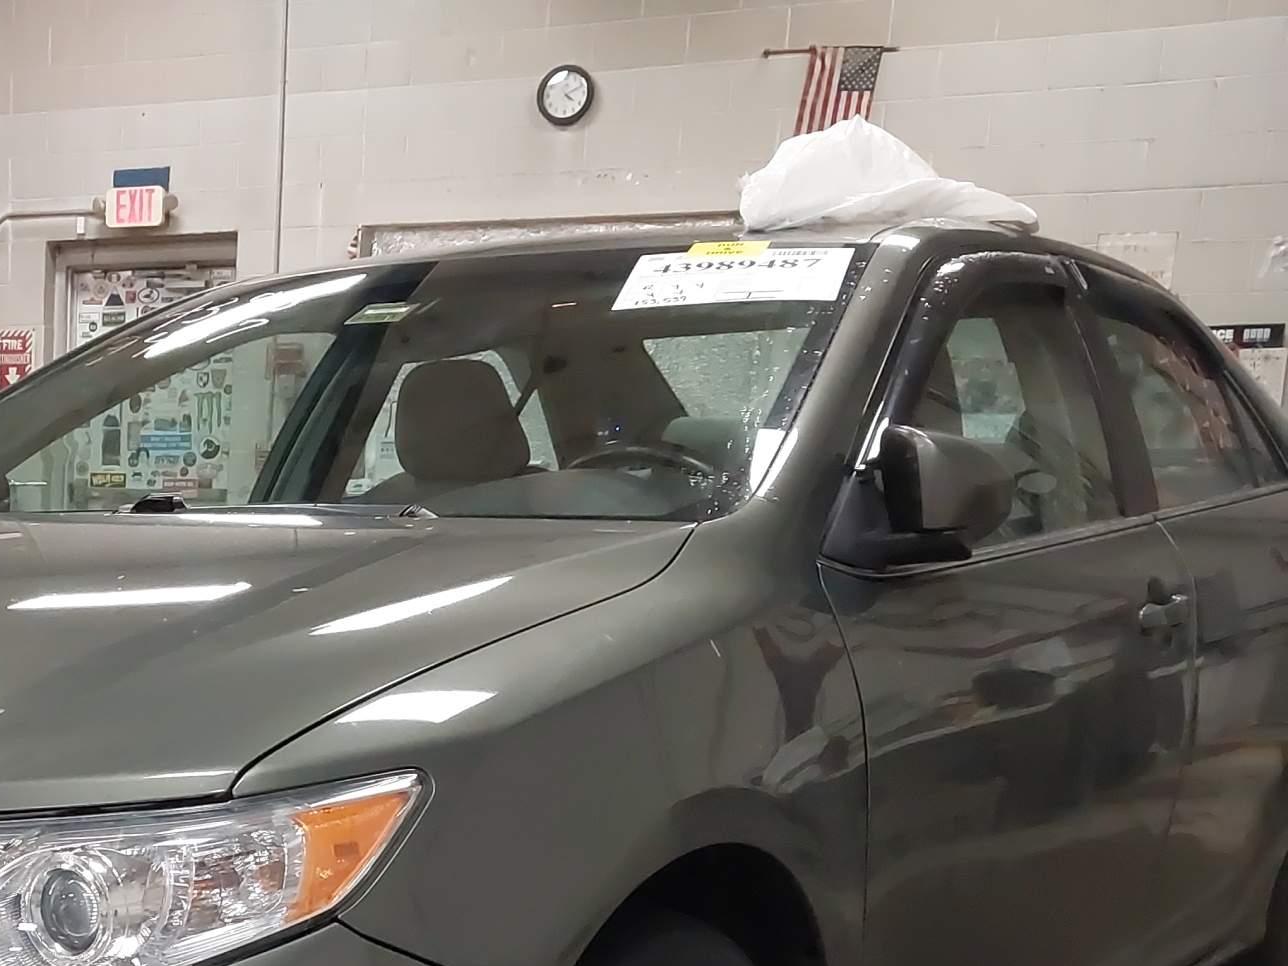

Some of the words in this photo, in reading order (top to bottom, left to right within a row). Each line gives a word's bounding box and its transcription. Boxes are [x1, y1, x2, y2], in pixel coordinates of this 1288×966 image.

[115, 188, 155, 224] EXIT
[654, 258, 822, 274] 43989487
[2, 339, 23, 350] FIRE
